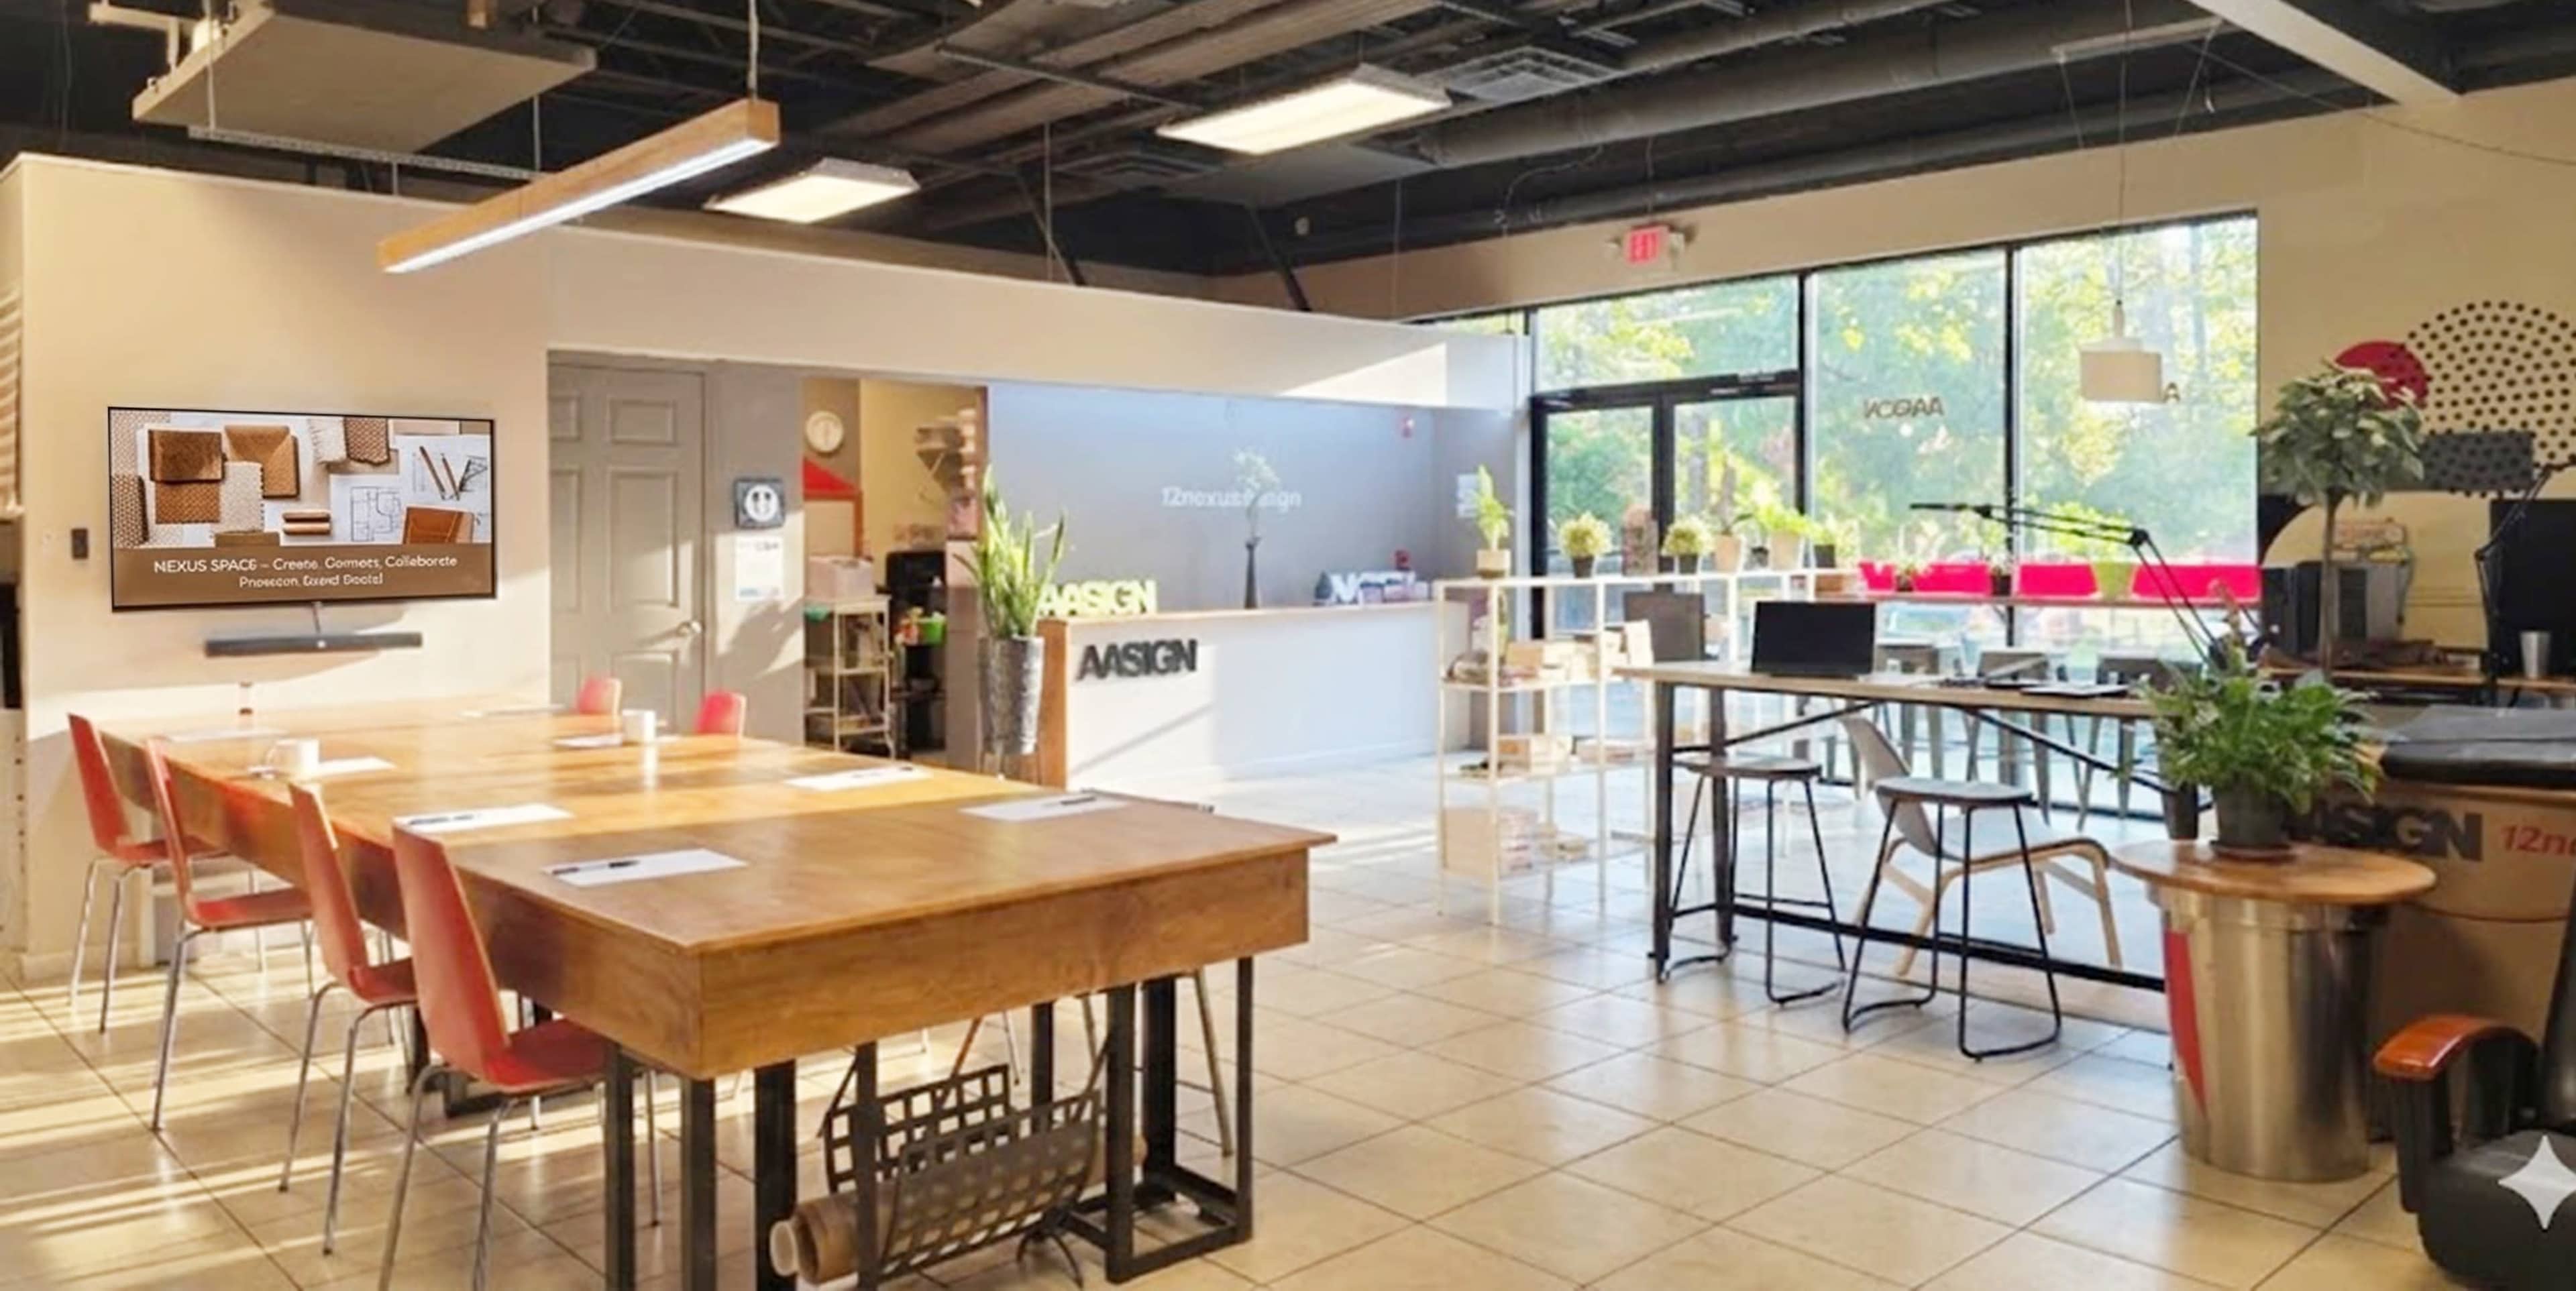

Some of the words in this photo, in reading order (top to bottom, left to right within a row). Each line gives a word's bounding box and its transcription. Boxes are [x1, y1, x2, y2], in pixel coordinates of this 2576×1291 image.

[154, 559, 207, 573] NEXUS
[1039, 579, 1158, 618] AASIGN
[1075, 638, 1197, 681] AASIGN
